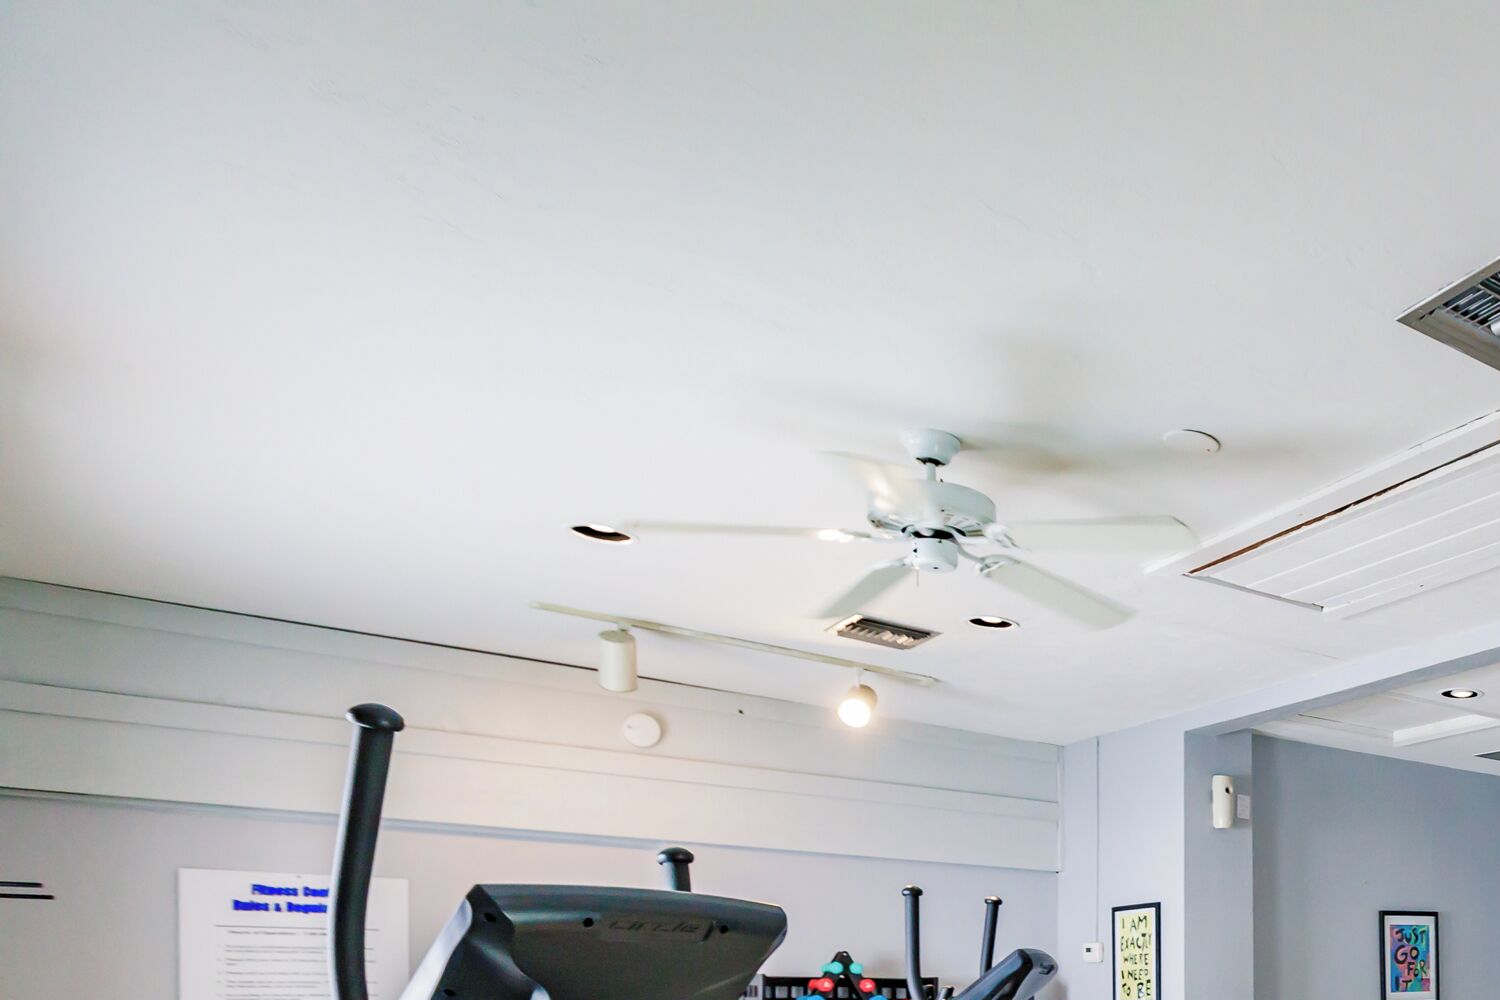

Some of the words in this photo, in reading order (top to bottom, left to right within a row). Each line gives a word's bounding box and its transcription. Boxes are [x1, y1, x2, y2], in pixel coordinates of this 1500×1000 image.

[1129, 915, 1148, 932] AM
[1395, 927, 1427, 944] JUST
[1394, 945, 1420, 964] GO
[1407, 959, 1428, 977] FOR
[1137, 979, 1151, 999] BE
[1395, 975, 1412, 991] IT
